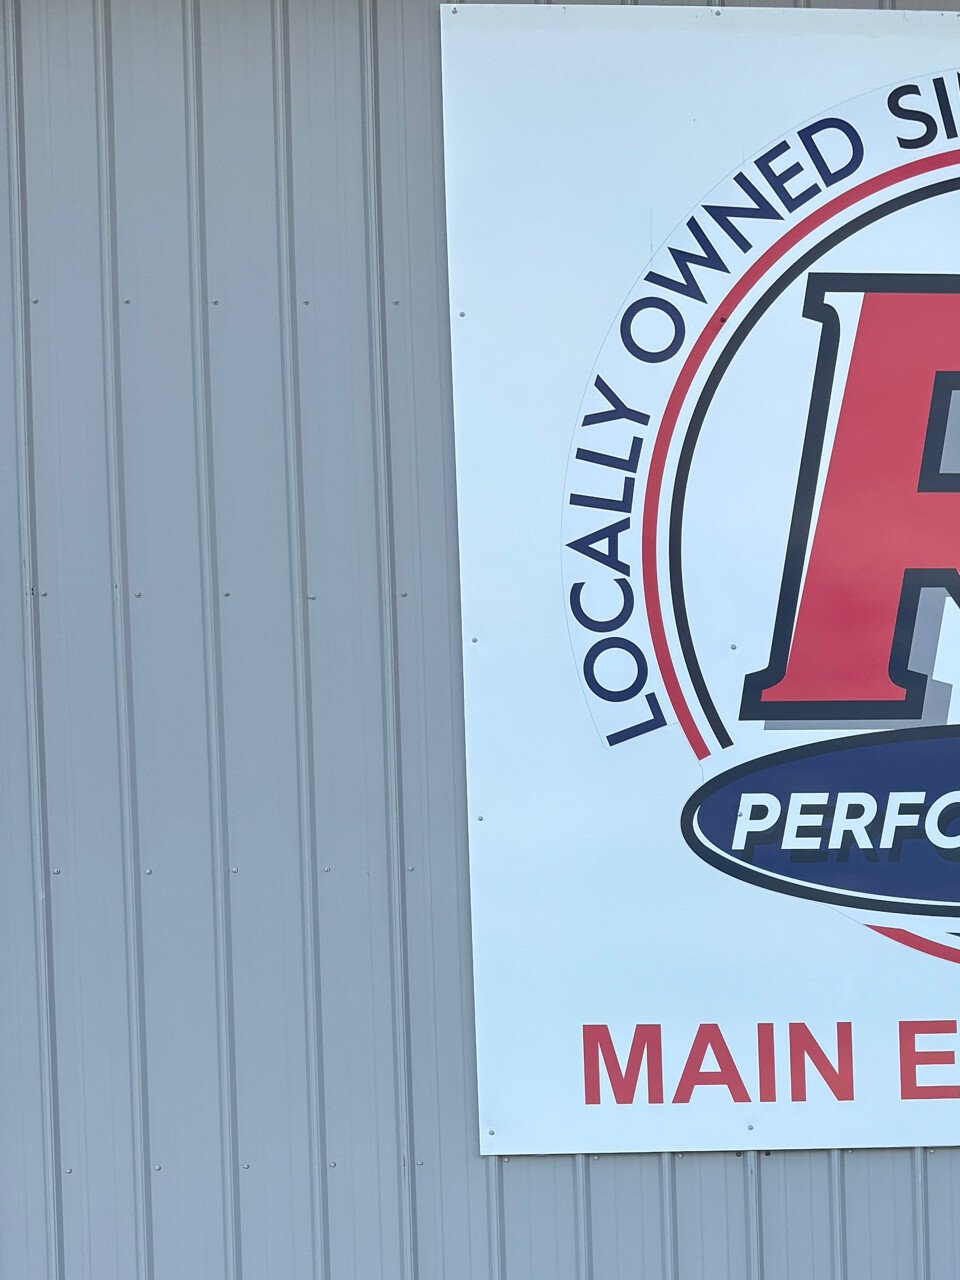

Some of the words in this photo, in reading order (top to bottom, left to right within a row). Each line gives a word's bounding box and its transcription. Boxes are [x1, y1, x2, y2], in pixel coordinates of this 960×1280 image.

[565, 374, 667, 747] LOCALLY
[620, 117, 864, 364] OWNED
[582, 1021, 854, 1106] MAIN
